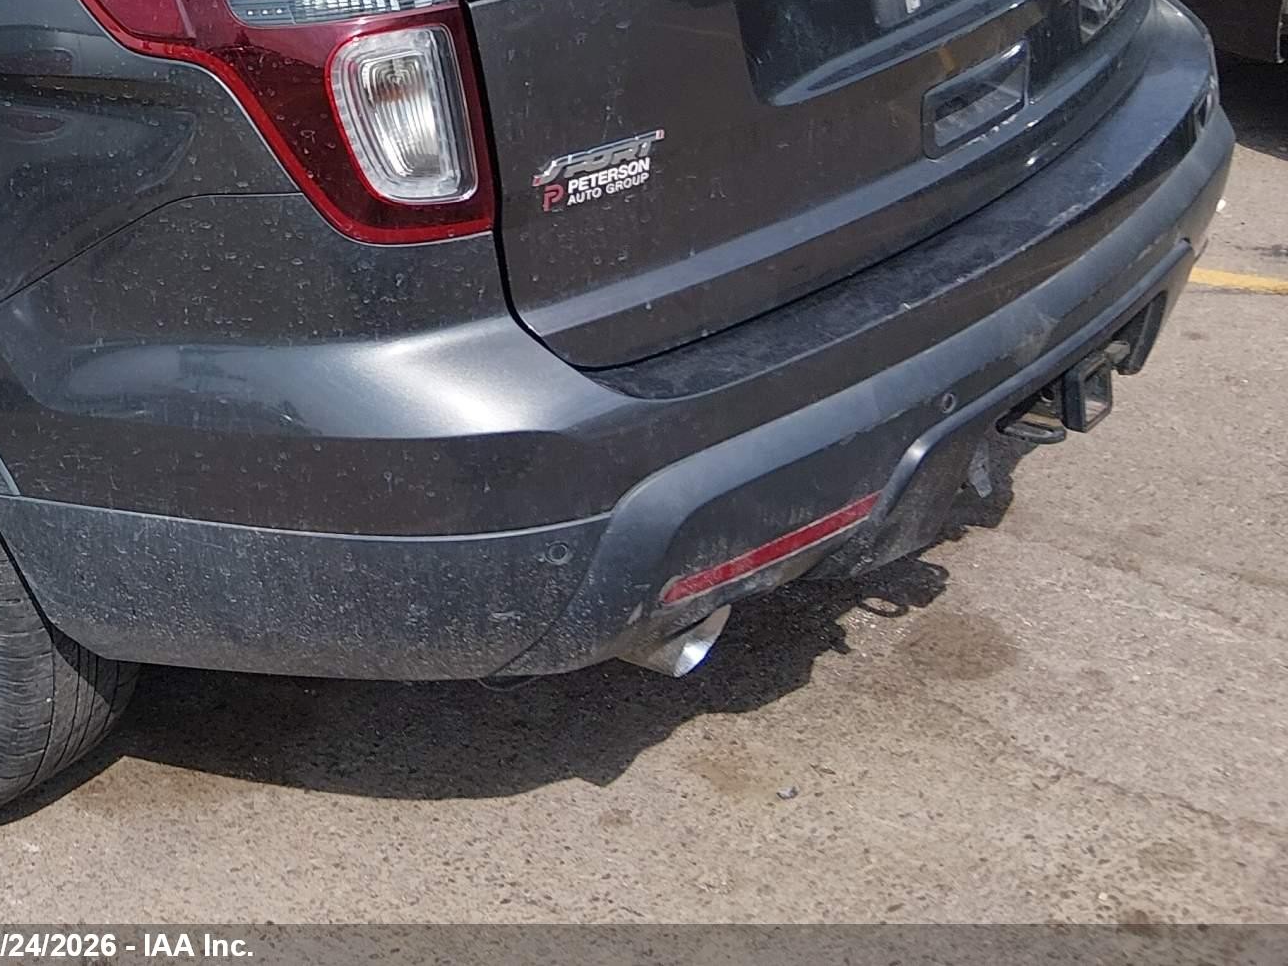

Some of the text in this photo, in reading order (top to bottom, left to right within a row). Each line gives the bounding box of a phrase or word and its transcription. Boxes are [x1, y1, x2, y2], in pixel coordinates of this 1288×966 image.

[531, 129, 665, 187] SPORT
[567, 156, 651, 195] PETERSON
[567, 171, 650, 206] AUTO GROUP
